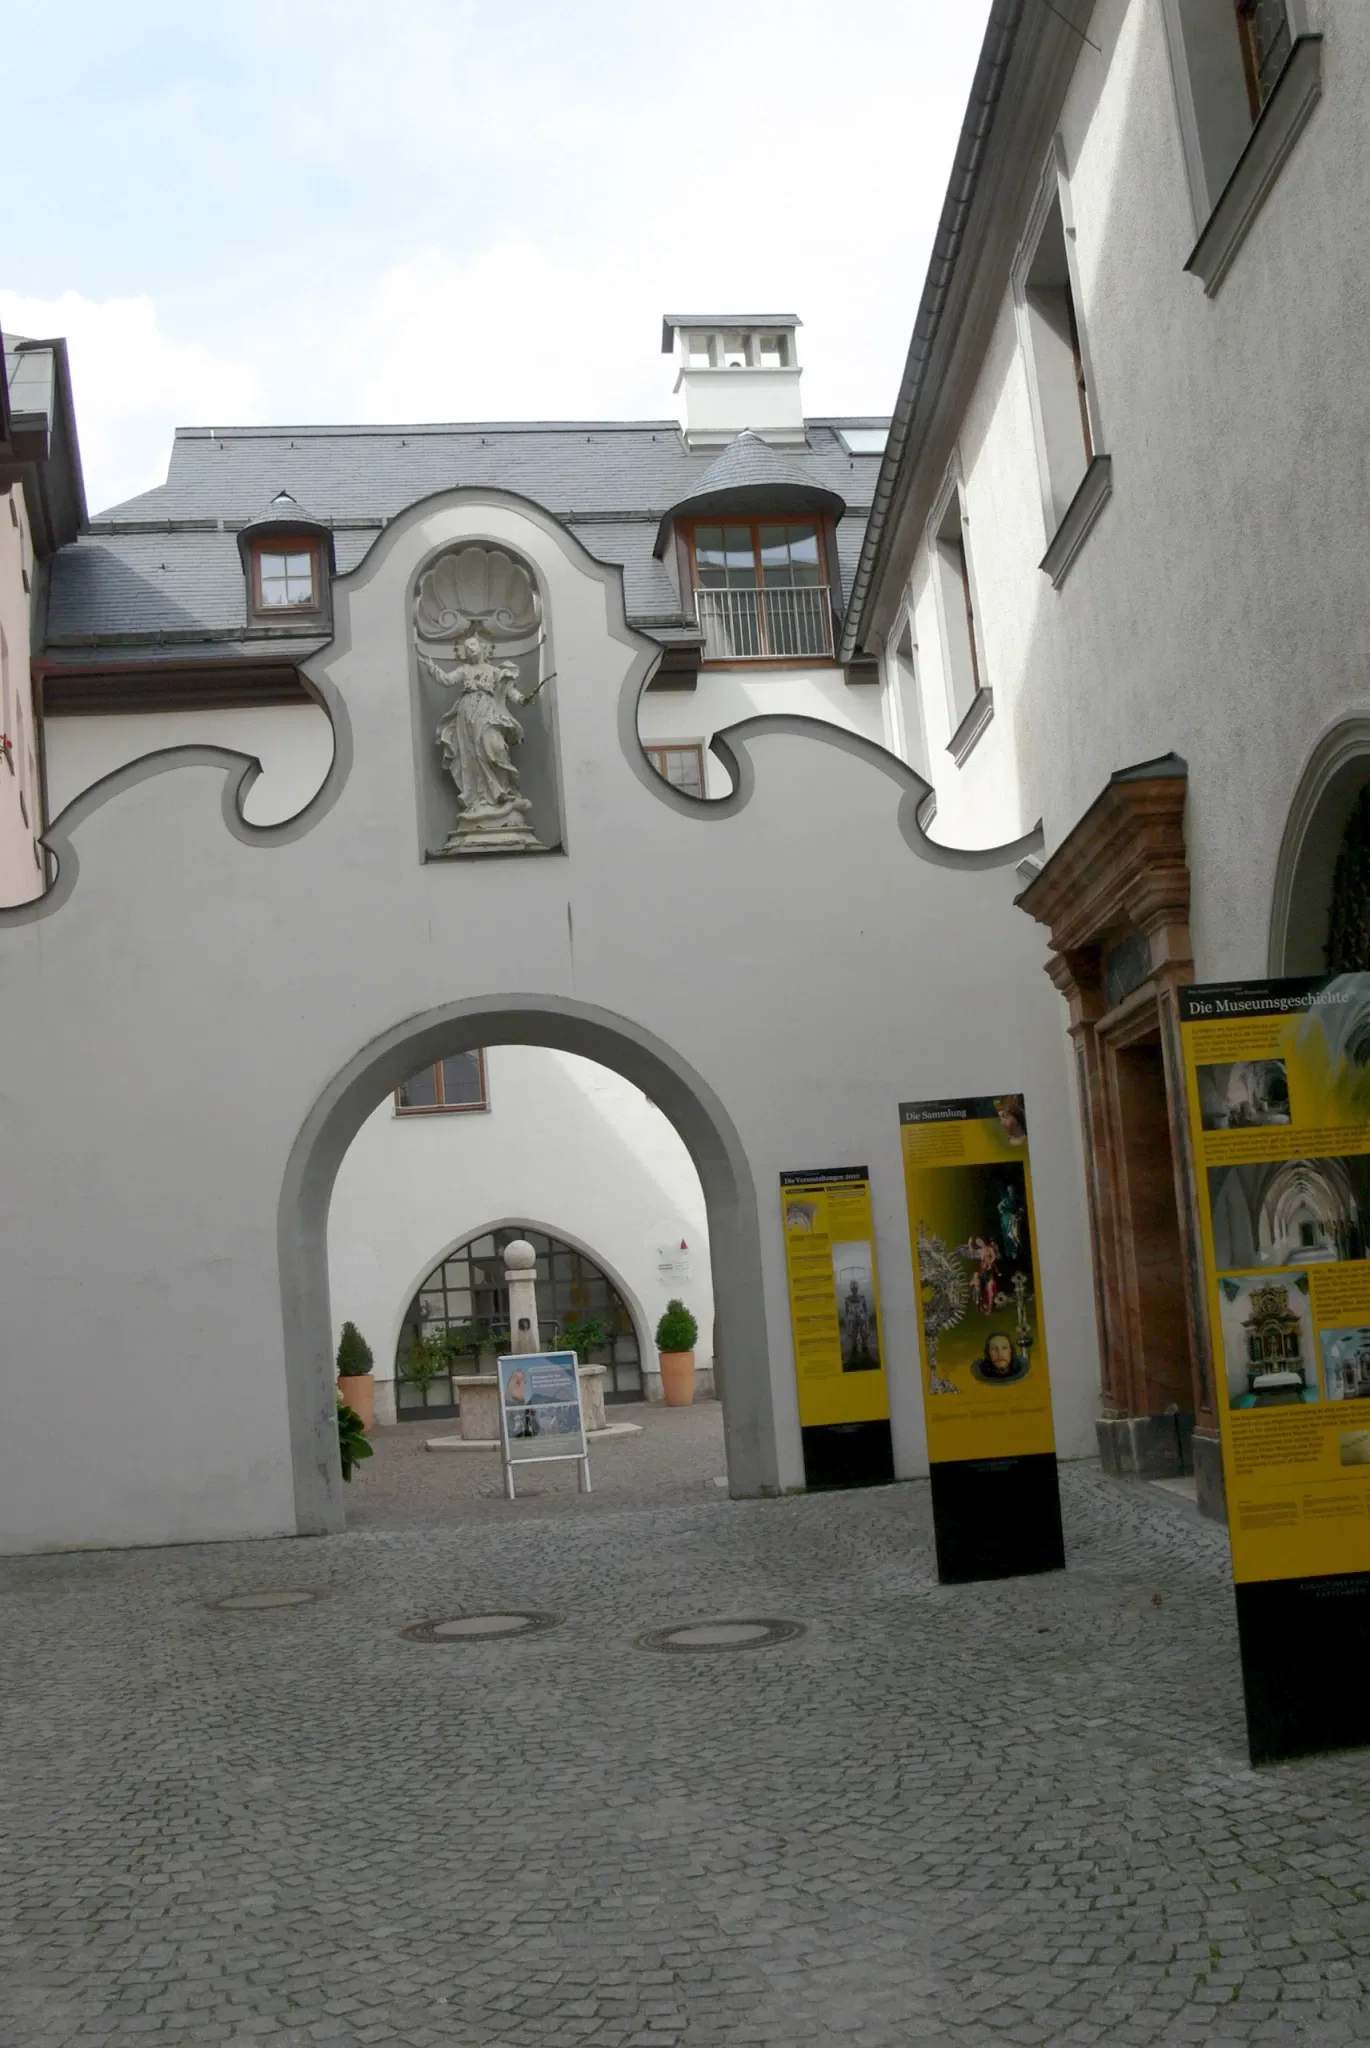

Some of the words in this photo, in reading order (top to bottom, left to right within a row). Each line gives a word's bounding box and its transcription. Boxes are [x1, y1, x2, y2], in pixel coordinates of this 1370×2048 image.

[1189, 1001, 1213, 1015] Die
[1216, 991, 1349, 1012] Museumsgeschichte
[906, 1112, 921, 1121] Die
[922, 1109, 967, 1120] Sammlung
[796, 1175, 844, 1183] Veranstaltungen
